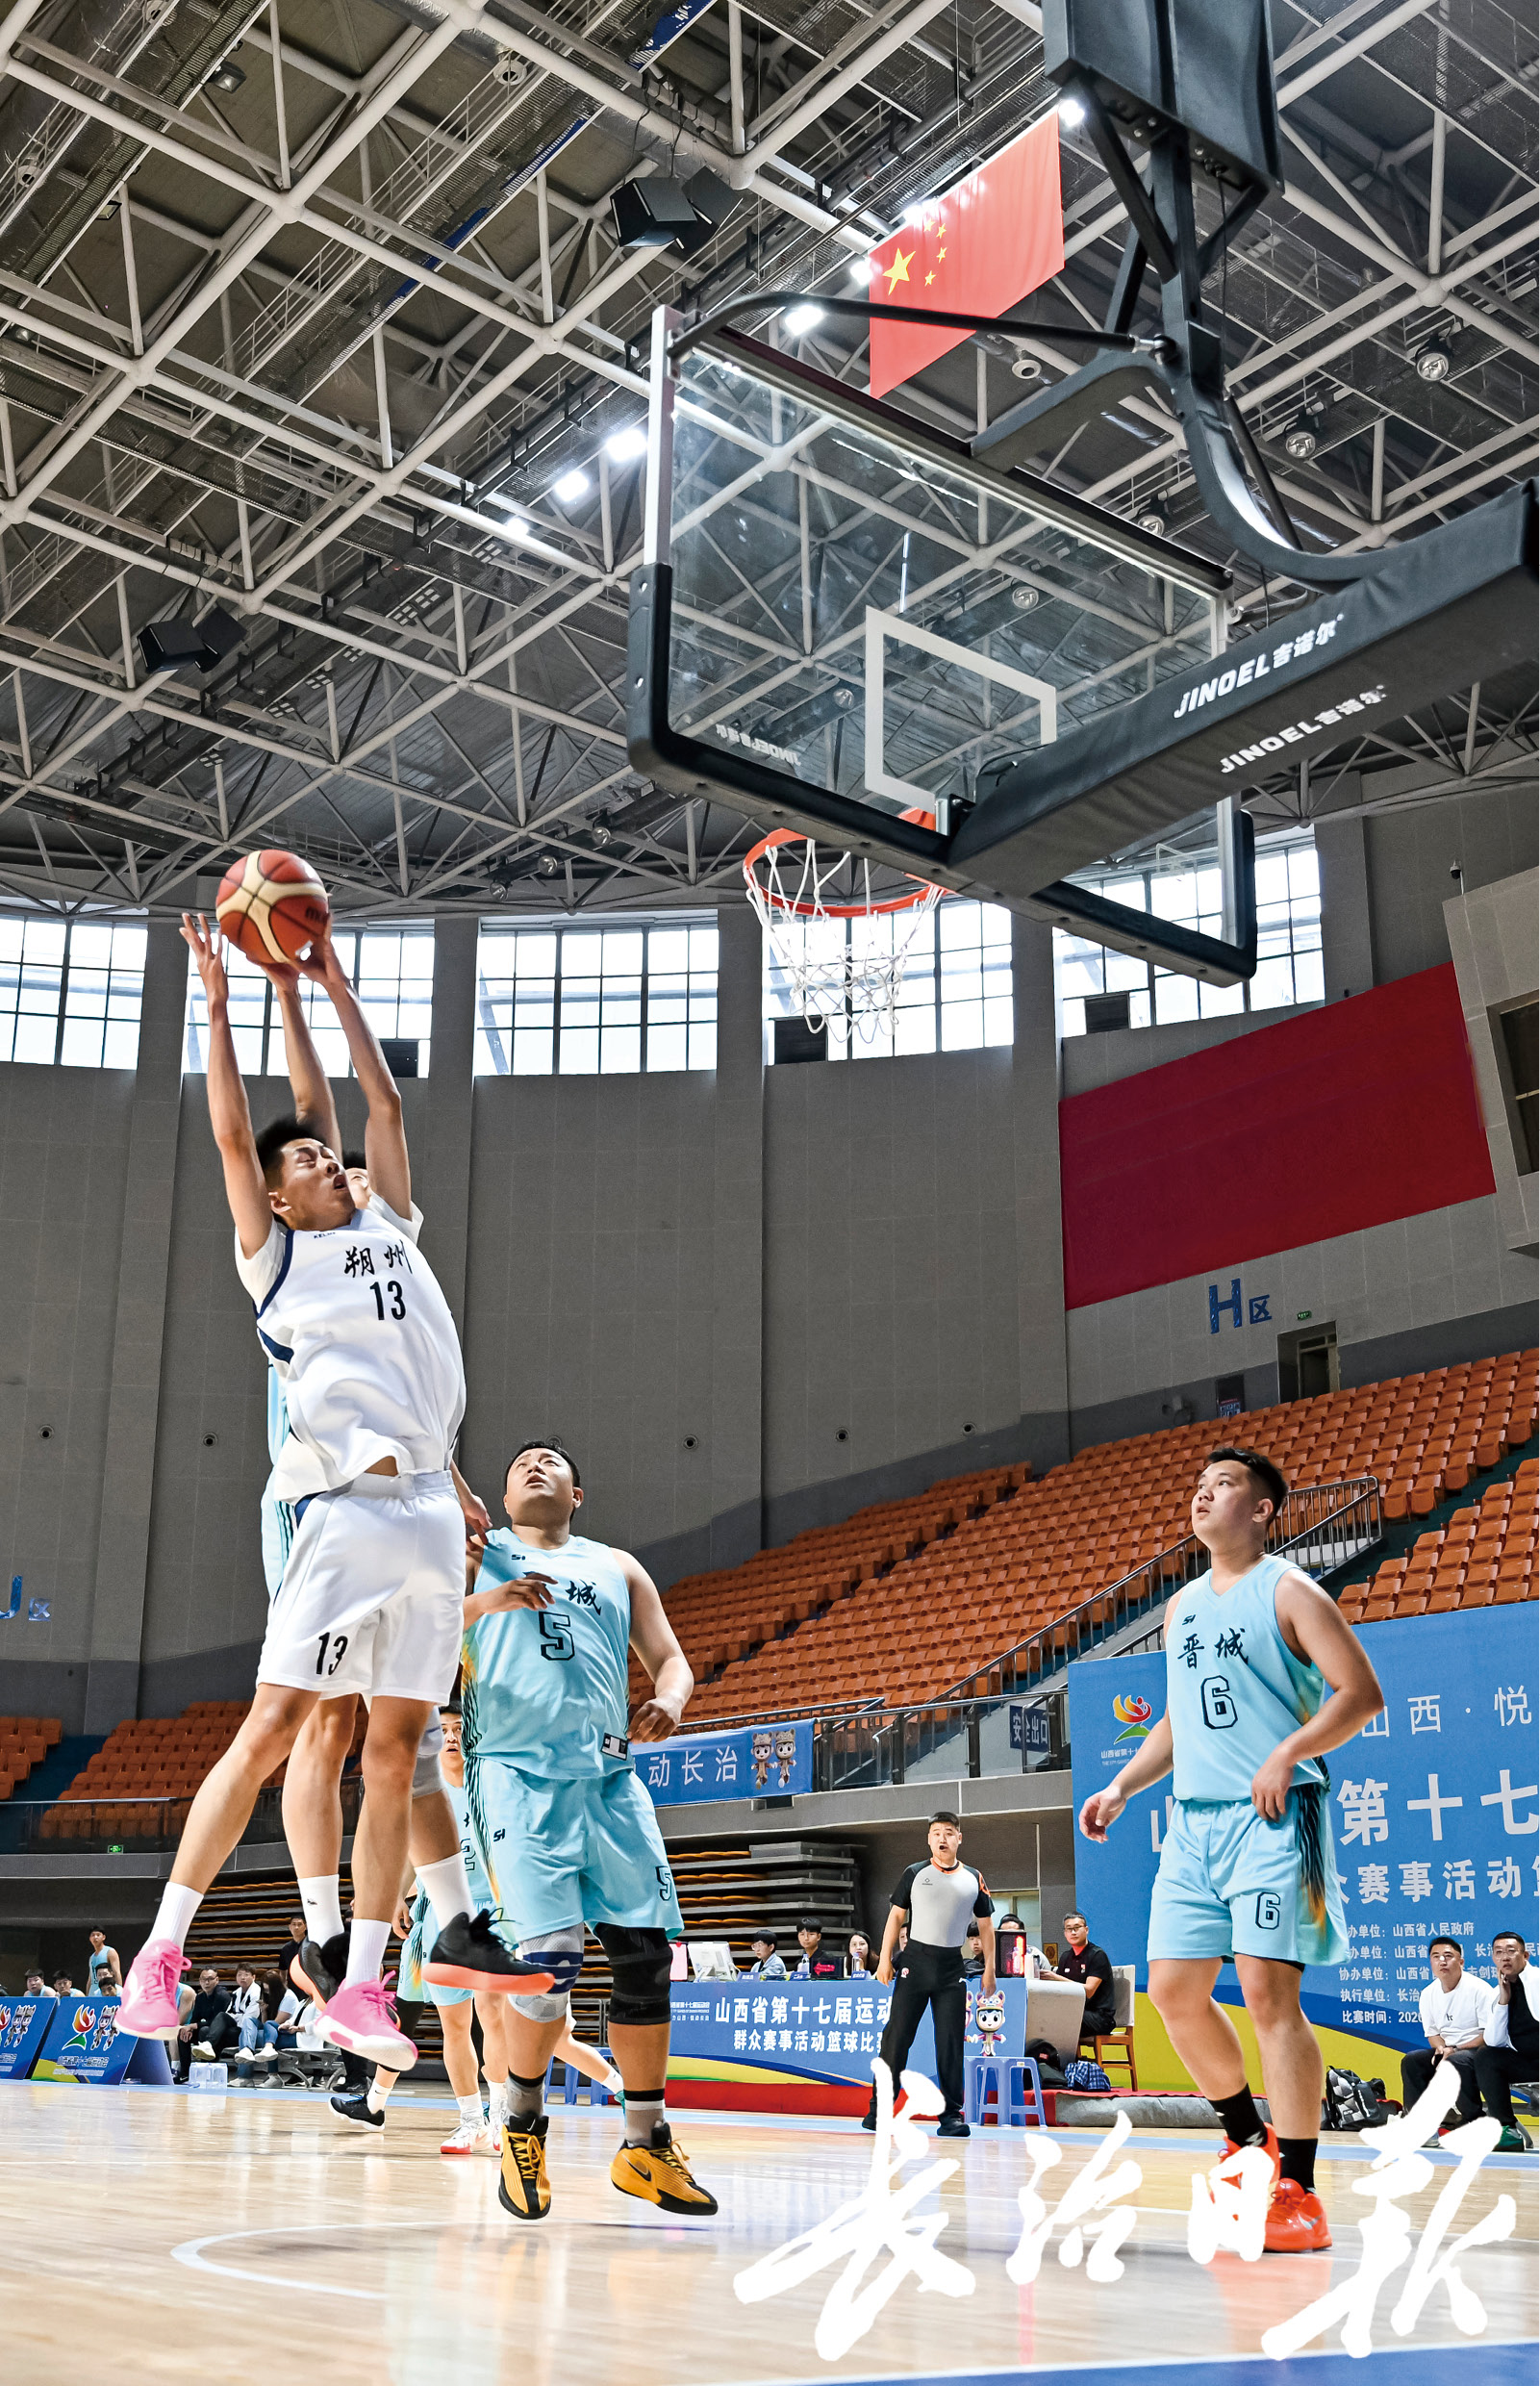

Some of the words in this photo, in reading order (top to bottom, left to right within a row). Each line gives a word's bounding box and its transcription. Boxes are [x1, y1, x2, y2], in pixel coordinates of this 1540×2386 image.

[1173, 652, 1271, 719] JINOEL
[1220, 721, 1323, 774] JINOEL
[343, 1239, 414, 1279] 朔州
[369, 1280, 407, 1321] 13
[316, 1632, 349, 1676] 13
[539, 1611, 575, 1661] 5
[1176, 1627, 1250, 1669] 晋城
[1199, 1675, 1239, 1730] 6
[647, 1745, 738, 1788] 动长治
[655, 1866, 672, 1901] 5
[1337, 1856, 1539, 1906] 赛事活动
[1255, 1891, 1280, 1930] 6
